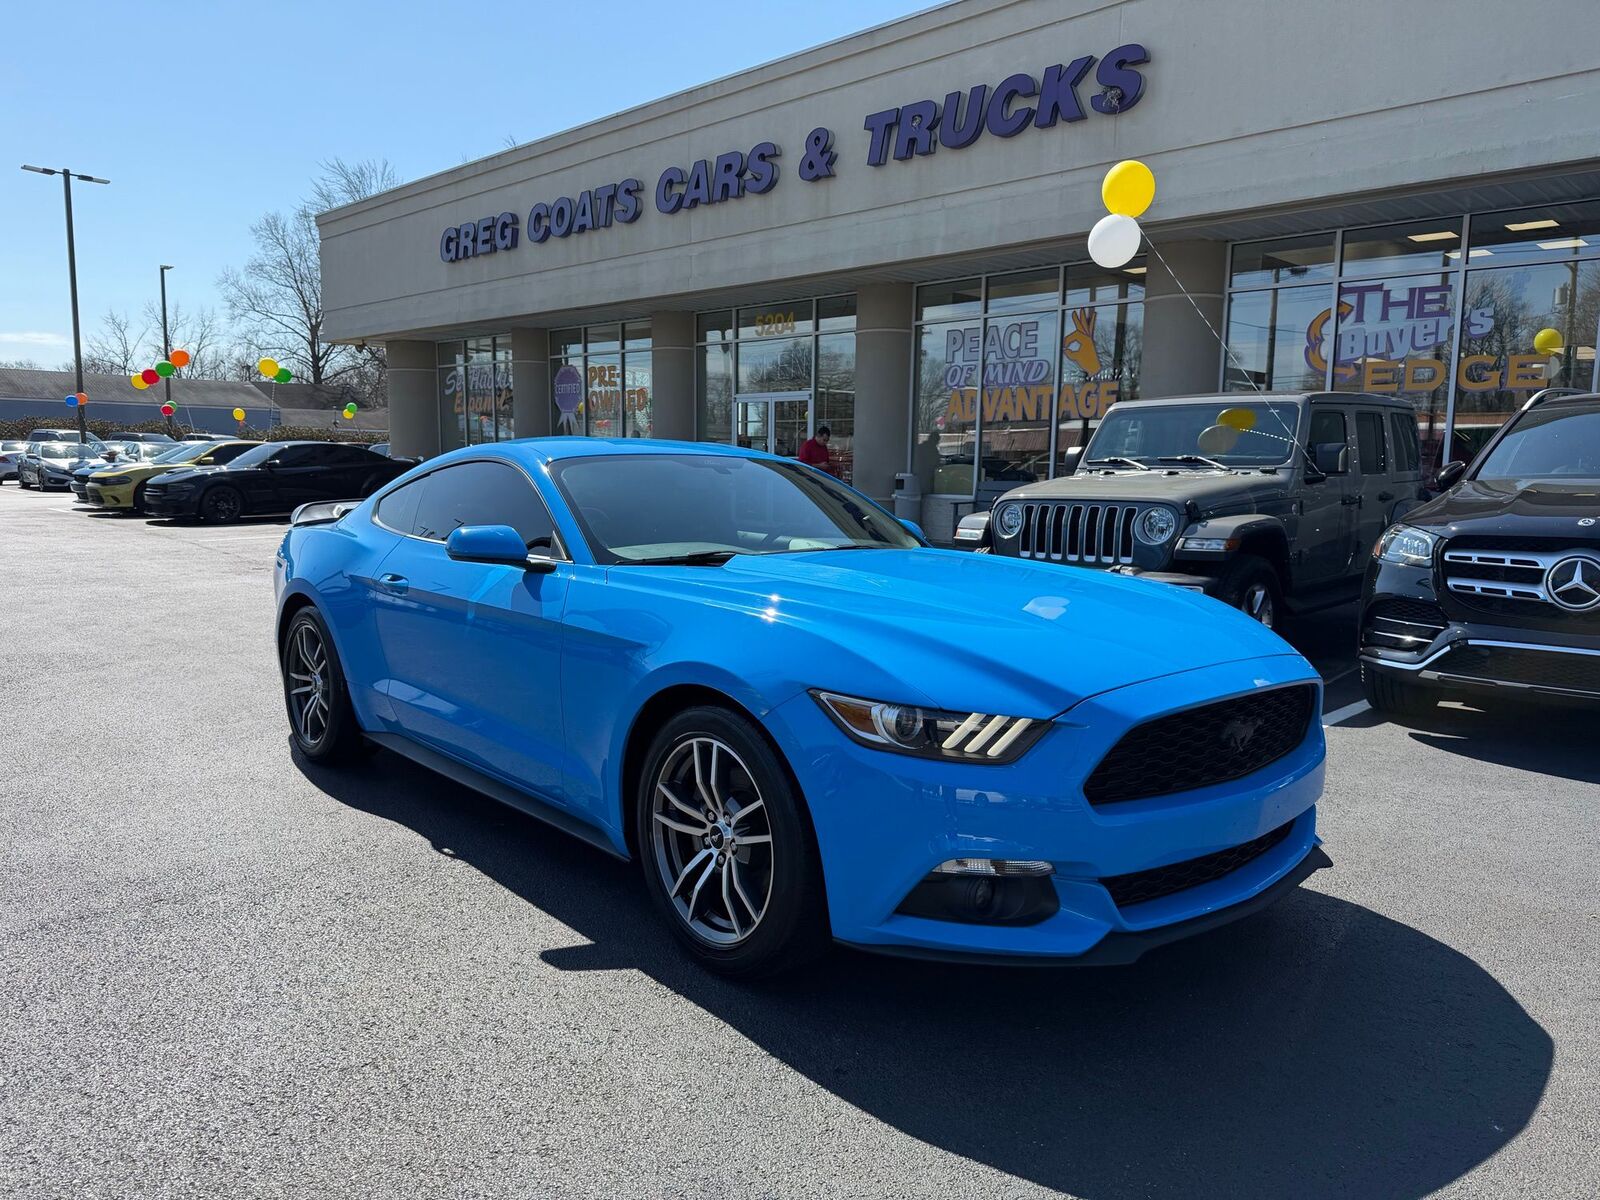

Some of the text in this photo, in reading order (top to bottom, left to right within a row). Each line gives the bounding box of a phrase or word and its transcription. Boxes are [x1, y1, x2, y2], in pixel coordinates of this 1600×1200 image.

[440, 44, 1150, 263] GREG COATS CARS & TRUCKS
[1340, 283, 1452, 323] THE
[755, 312, 796, 336] 5204
[946, 321, 1039, 363] PEACE
[556, 383, 580, 394] CERTIFIED
[945, 360, 1050, 388] OF MIND
[1362, 354, 1551, 392] EDGE
[946, 381, 1120, 423] ADVANTAGE
